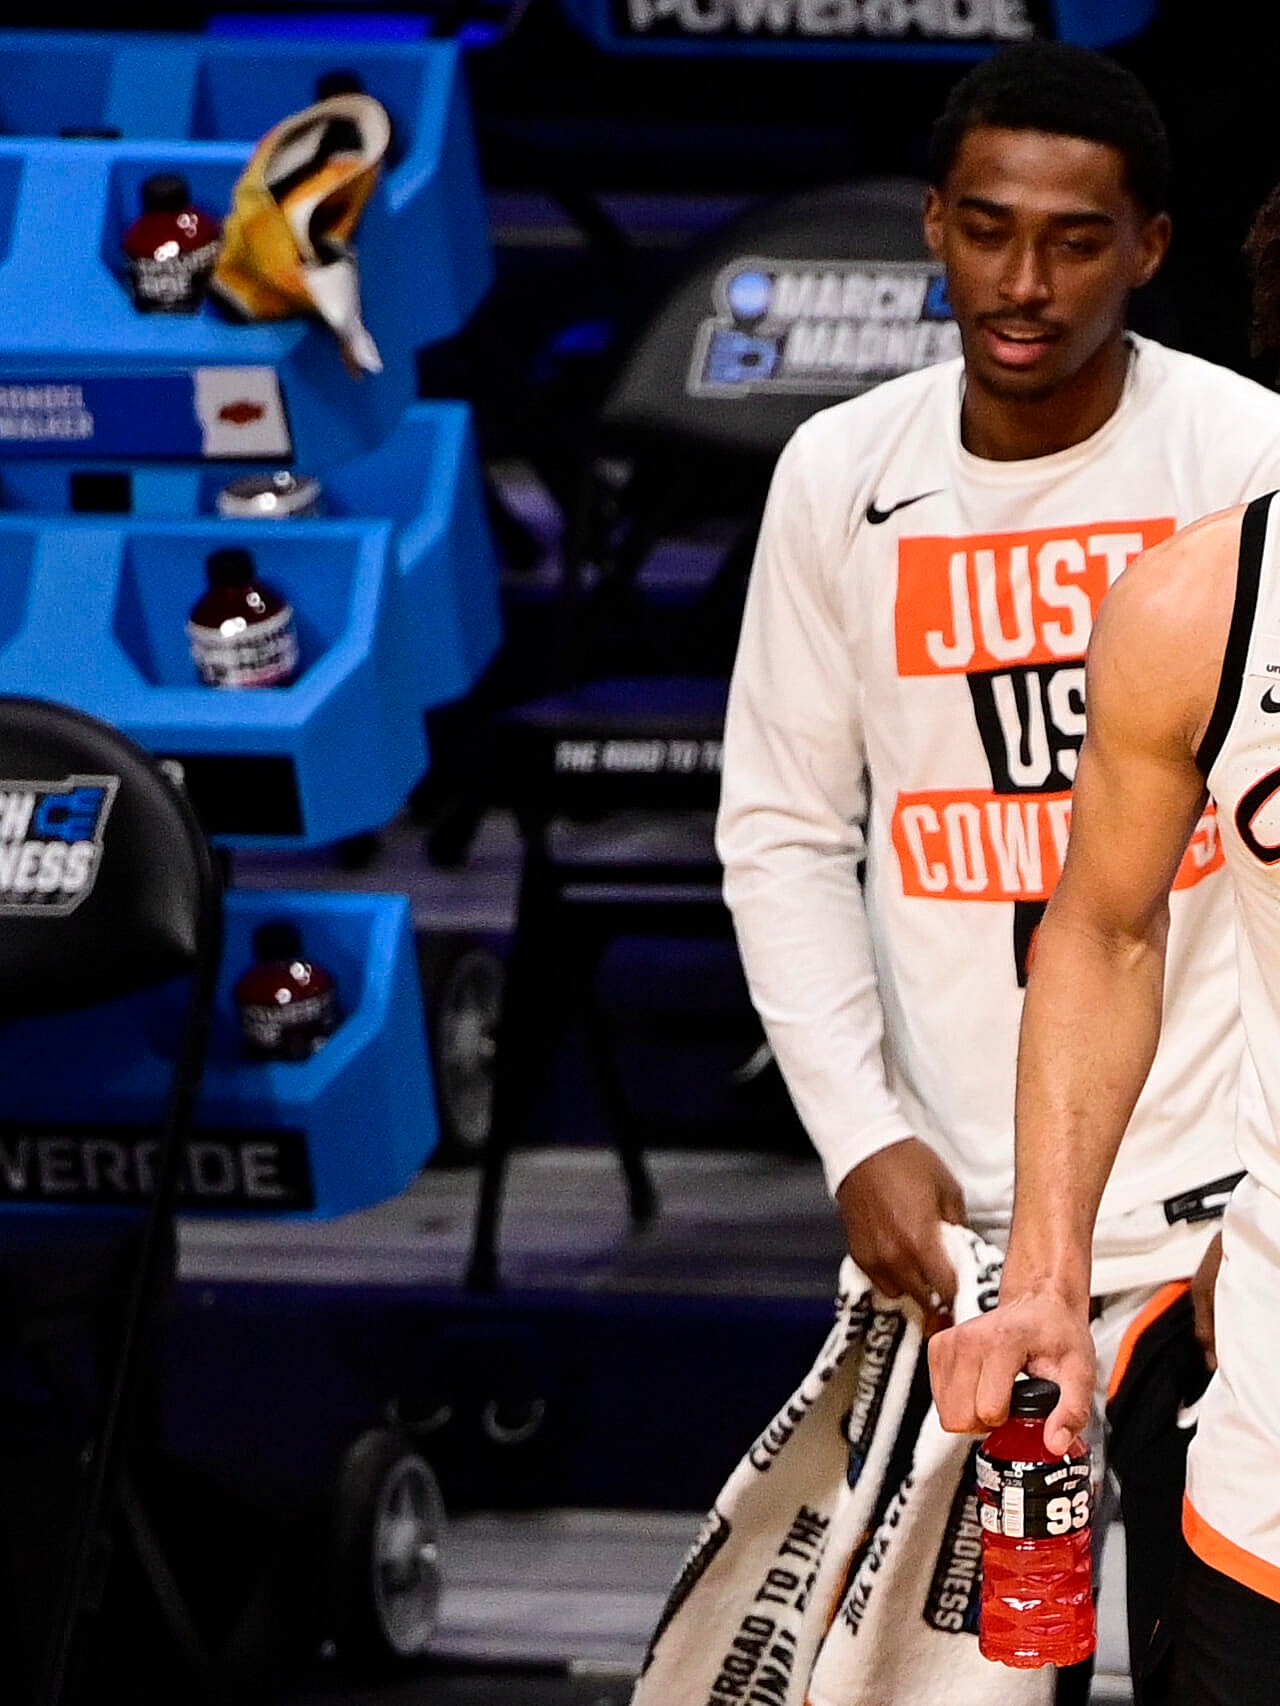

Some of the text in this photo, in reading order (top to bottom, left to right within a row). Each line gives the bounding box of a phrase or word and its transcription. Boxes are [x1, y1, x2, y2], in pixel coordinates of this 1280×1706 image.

[772, 272, 928, 319] MARCH
[925, 533, 1143, 668] JUST
[1046, 1490, 1089, 1535] 93
[712, 1615, 775, 1697] ROAD
[755, 1567, 799, 1604] TO
[778, 1504, 830, 1560] THE
